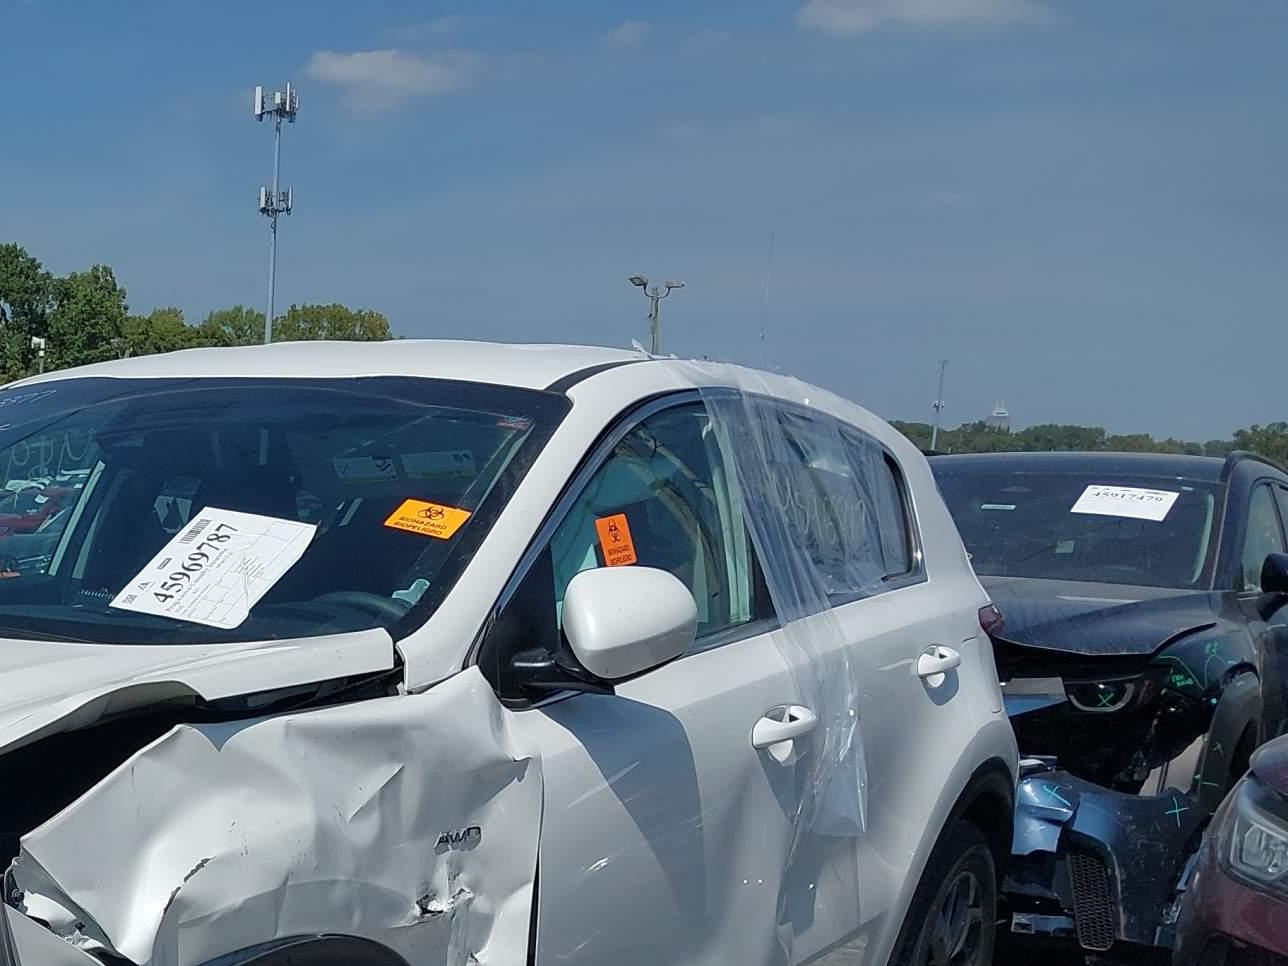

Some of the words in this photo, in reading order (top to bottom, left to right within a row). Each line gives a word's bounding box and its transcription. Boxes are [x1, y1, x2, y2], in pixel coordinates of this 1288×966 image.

[394, 521, 443, 536] BIOPELIGRO
[398, 515, 448, 531] BIOHAZARD
[153, 523, 240, 603] 45969787
